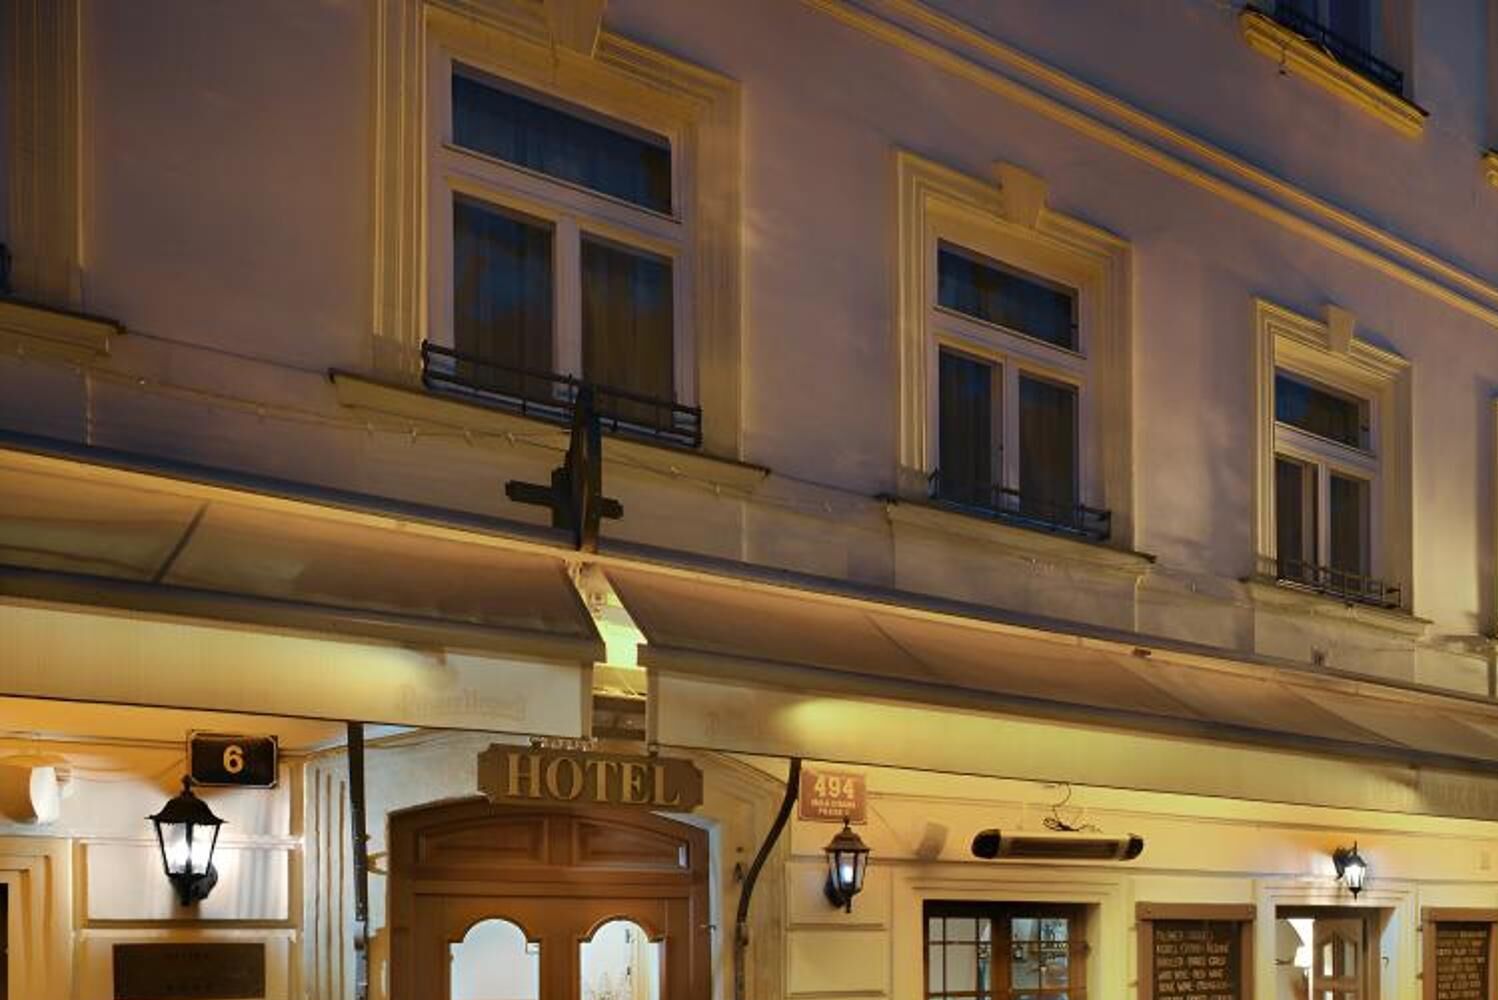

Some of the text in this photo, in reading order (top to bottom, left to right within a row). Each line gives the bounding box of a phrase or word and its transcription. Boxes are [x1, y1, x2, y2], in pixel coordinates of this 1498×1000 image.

[223, 744, 245, 774] 6
[506, 752, 681, 806] HOTEL
[814, 774, 855, 799] 494
